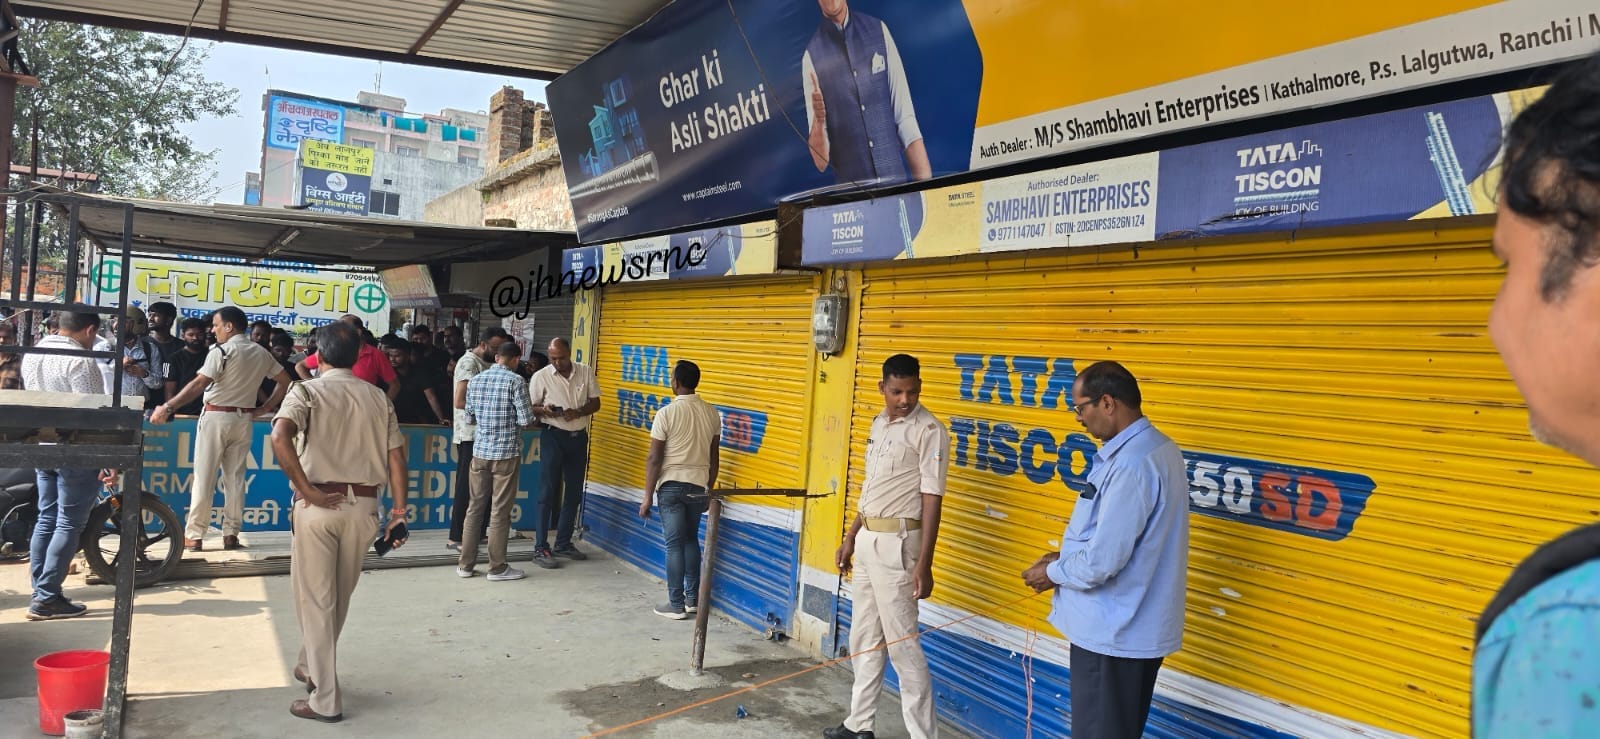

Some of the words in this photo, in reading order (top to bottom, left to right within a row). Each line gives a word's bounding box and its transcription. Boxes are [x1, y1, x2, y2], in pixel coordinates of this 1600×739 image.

[659, 67, 699, 108] Ghar
[701, 48, 723, 90] ki
[980, 143, 1000, 159] Auth
[1034, 122, 1064, 148] M/S
[1067, 102, 1152, 140] Shambhavi
[1155, 83, 1260, 123] Enterprises
[1271, 67, 1366, 100] Kathalmore,
[1369, 60, 1397, 81] P.s.
[1401, 41, 1494, 75] Lalgutwa,
[1499, 17, 1573, 54] Ranchi
[670, 112, 704, 152] Asli
[704, 83, 770, 140] Shakti
[1237, 142, 1297, 168] TATA
[681, 180, 742, 202] www.captainsteel.com
[1028, 176, 1069, 192] Authorised
[1070, 172, 1100, 186] Dealer:
[1234, 165, 1321, 193] TISCON
[833, 210, 855, 225] TATA
[987, 193, 1050, 224] SAMBHAVI
[1053, 180, 1151, 217] ENTERPRISES
[1253, 205, 1267, 219] OF
[1269, 201, 1320, 217] BUILDING
[832, 225, 864, 240] TISCON
[998, 223, 1046, 241] 9771147047
[134, 260, 355, 313] दवाखाना
[621, 344, 671, 387] TATA
[954, 354, 1078, 411] TATA
[949, 416, 1098, 492] TISCO
